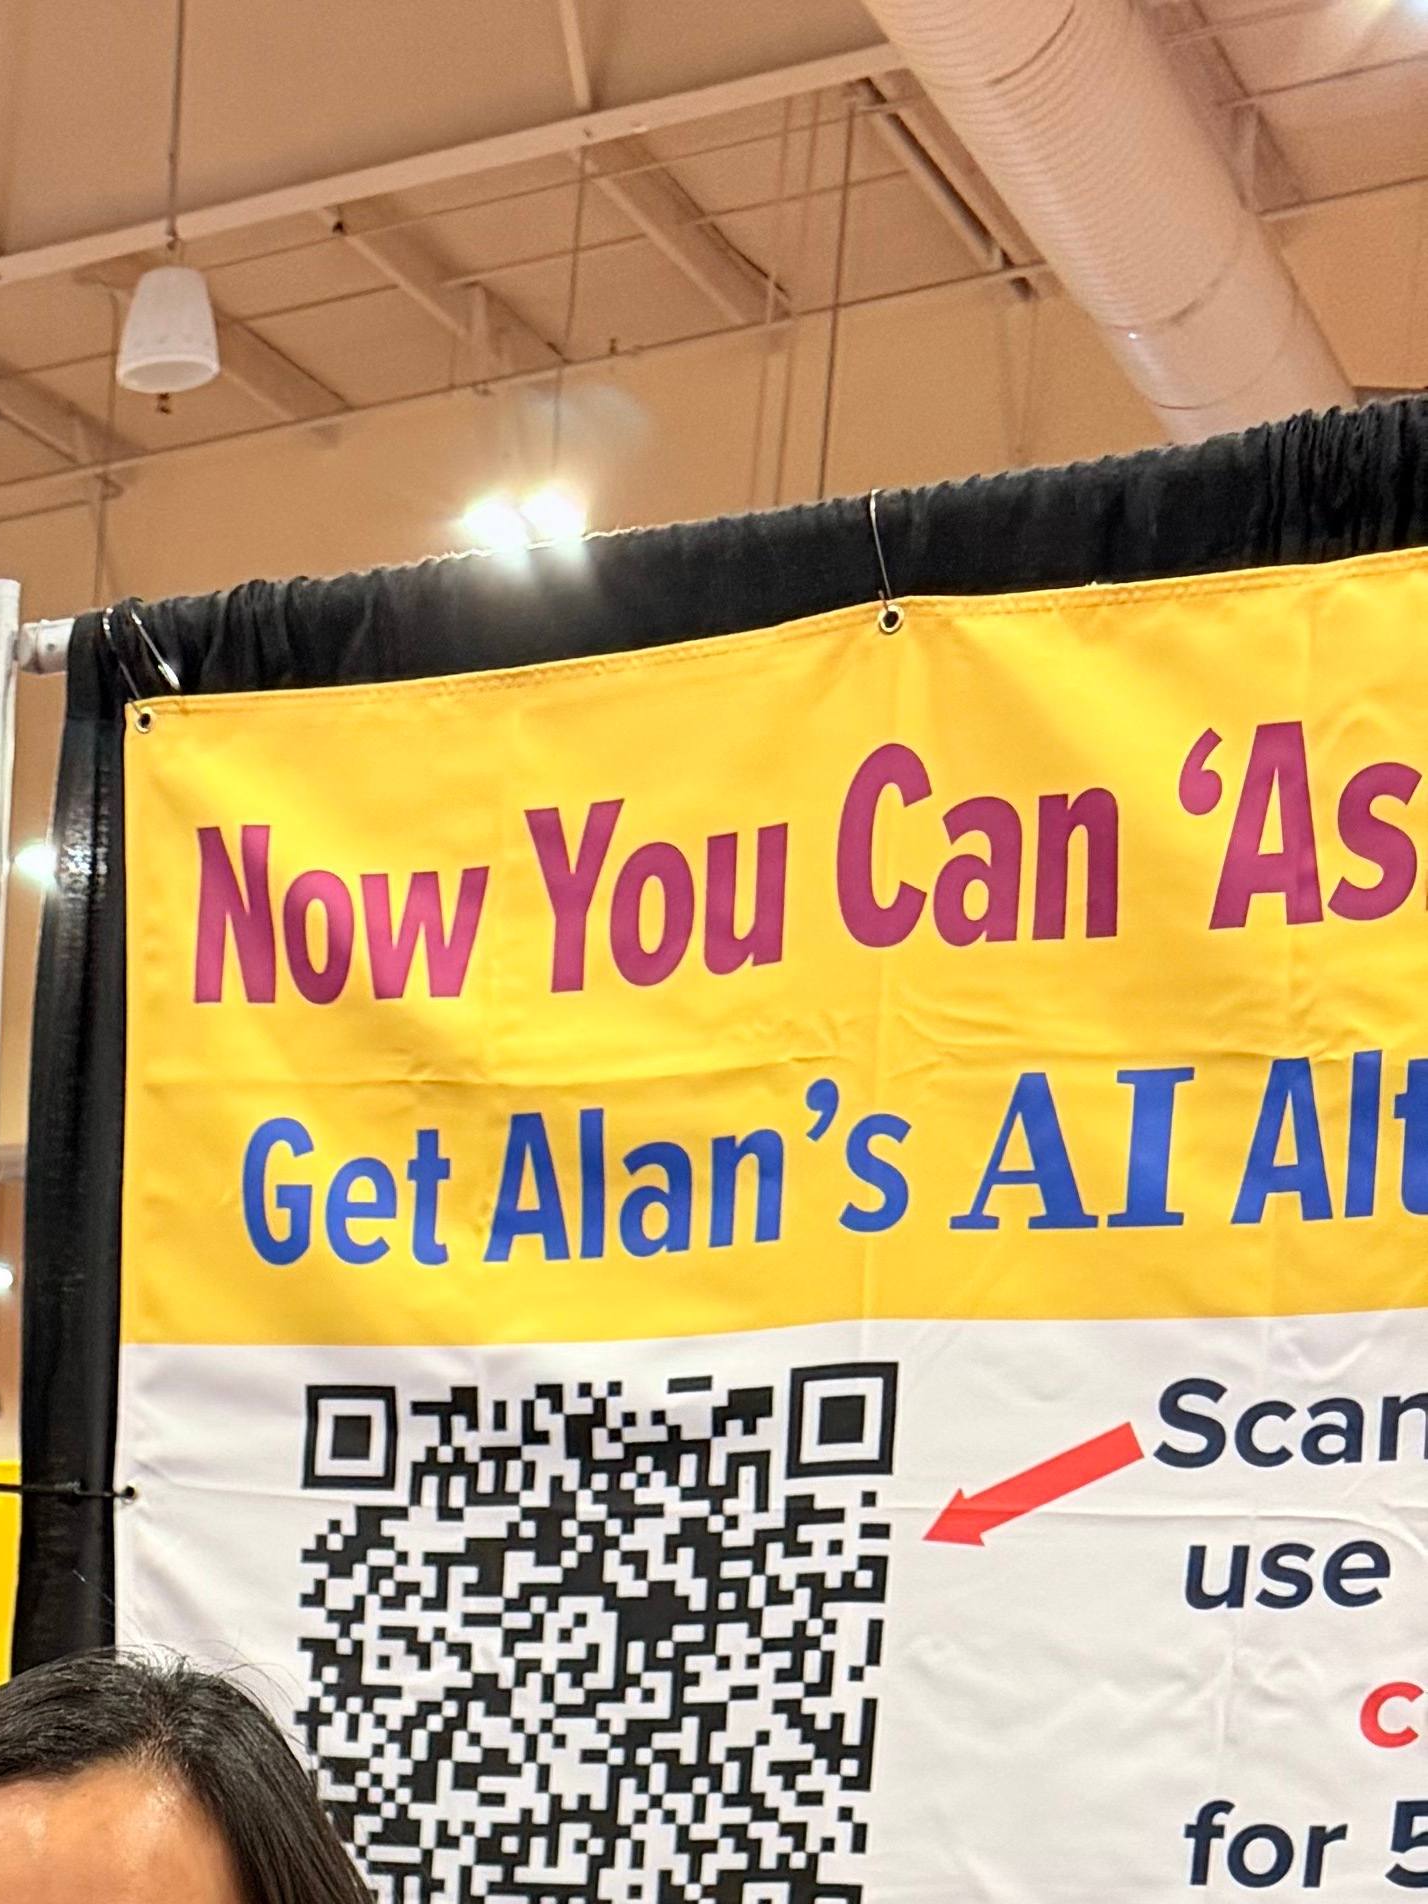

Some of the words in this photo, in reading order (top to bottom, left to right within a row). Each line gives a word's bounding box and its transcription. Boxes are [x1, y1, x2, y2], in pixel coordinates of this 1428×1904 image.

[193, 823, 490, 1006] Now
[523, 797, 789, 993] You
[836, 742, 1120, 949] Can
[1178, 720, 1428, 931] ‘As
[241, 1115, 452, 1266] Get
[484, 1077, 912, 1265] Alan’s
[950, 1065, 1196, 1232] AI
[1153, 1377, 1428, 1469] Scan
[1185, 1540, 1391, 1610] use
[1184, 1800, 1349, 1889] for
